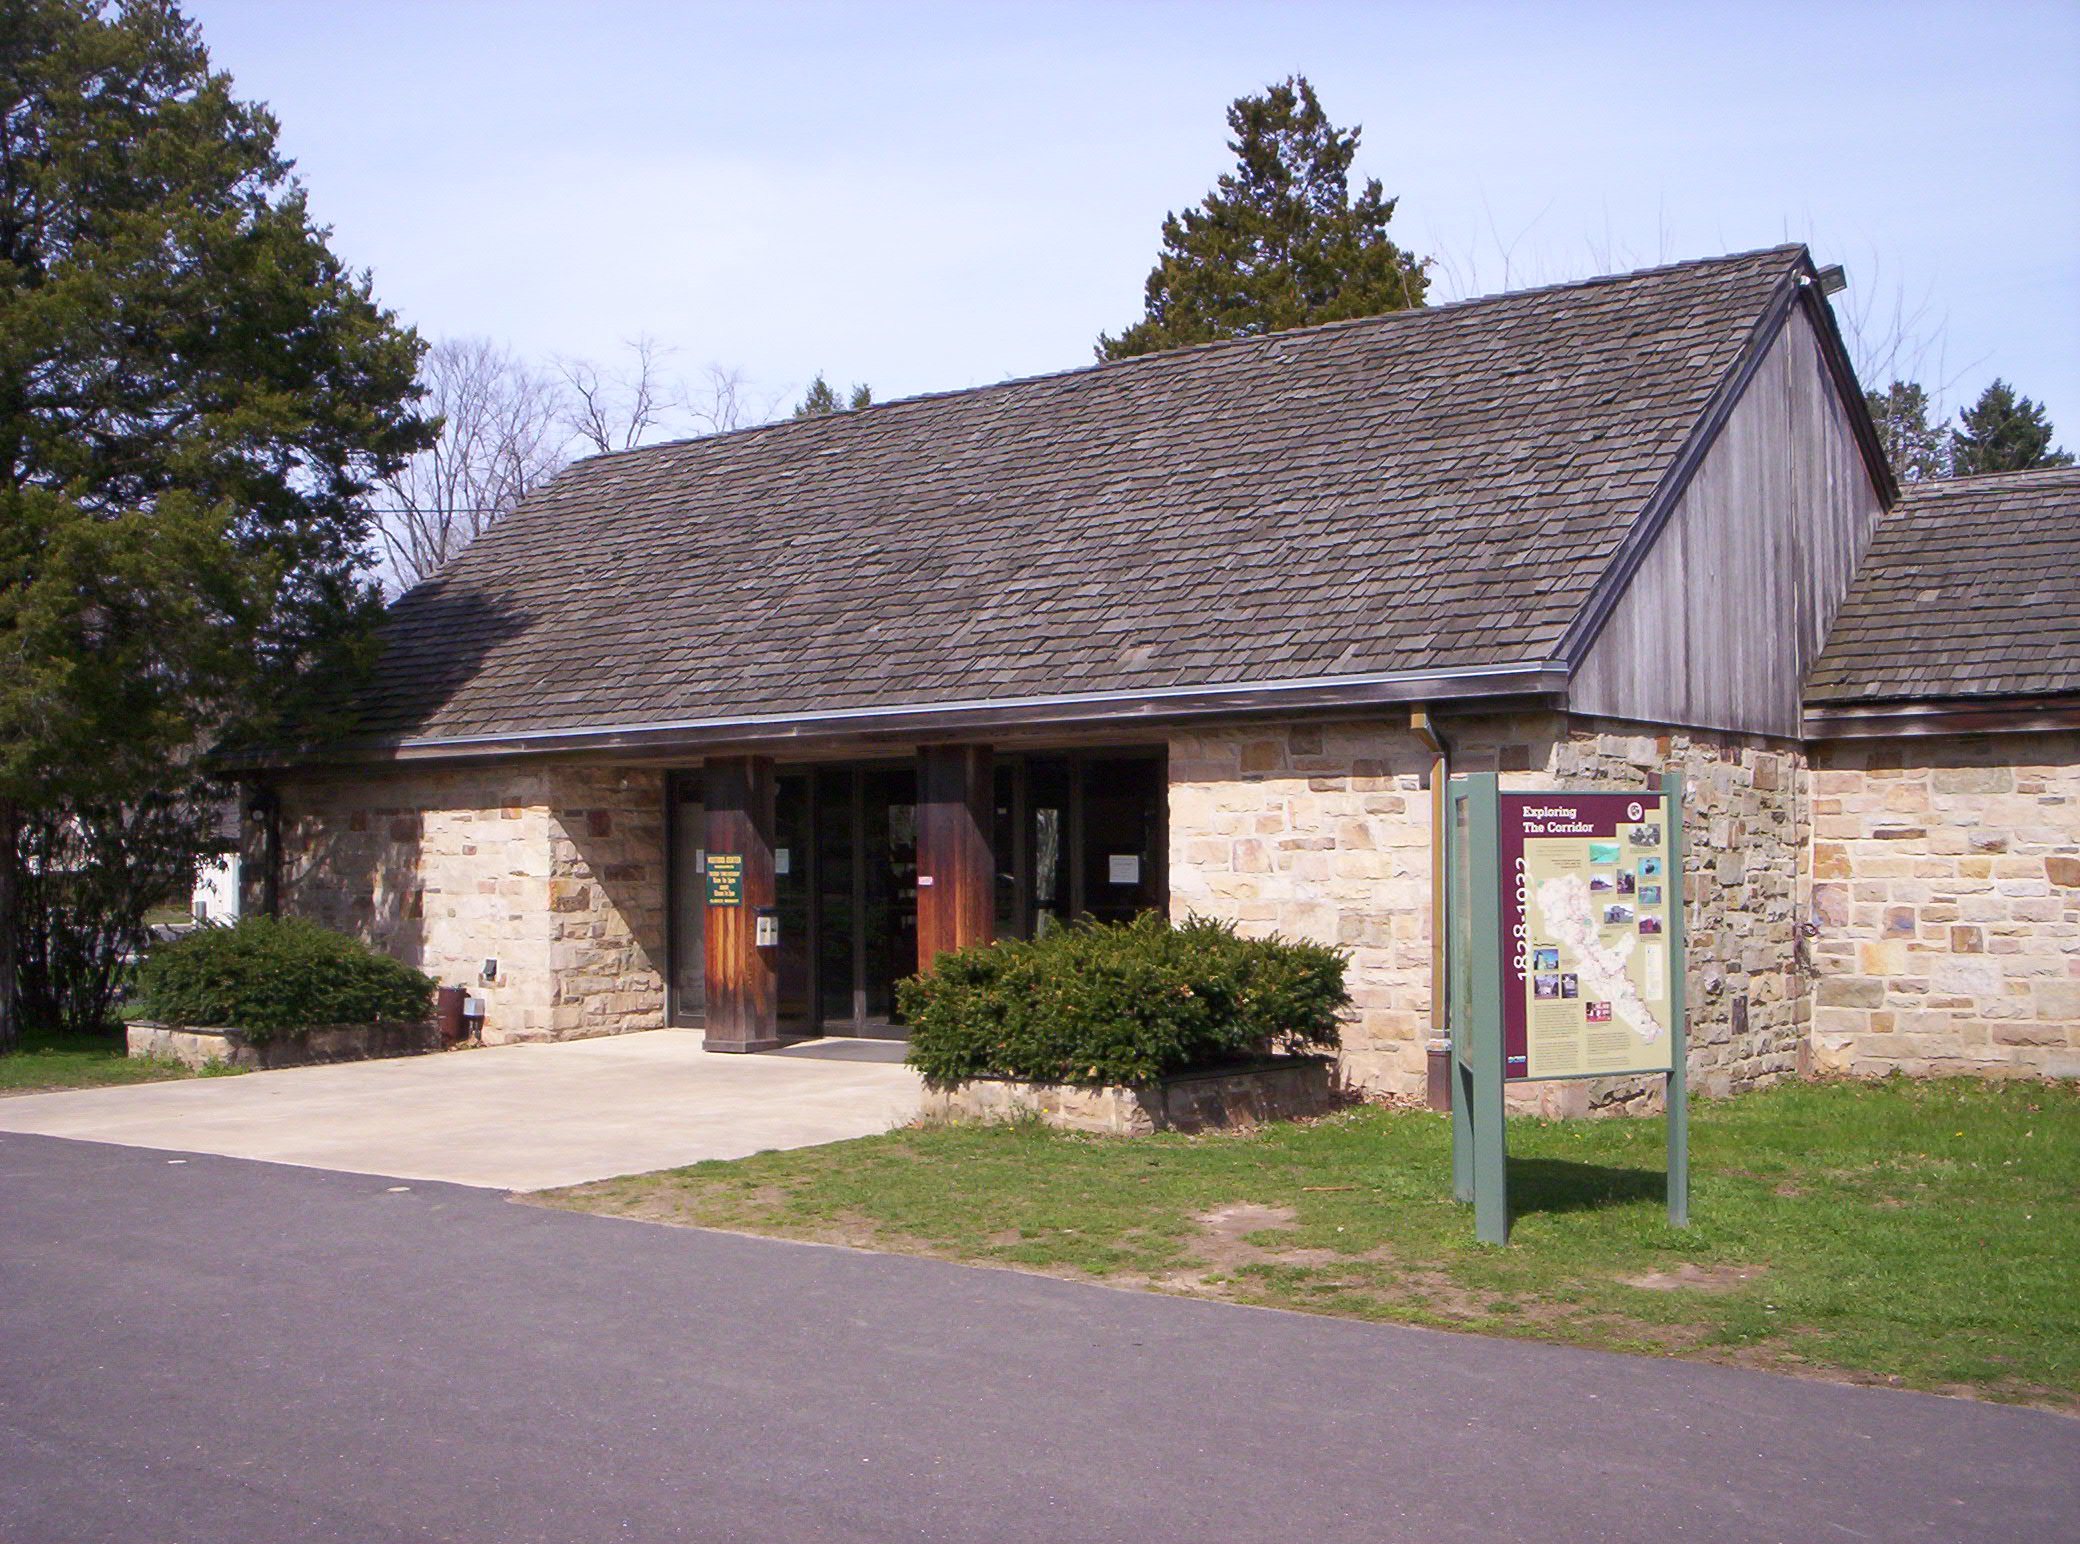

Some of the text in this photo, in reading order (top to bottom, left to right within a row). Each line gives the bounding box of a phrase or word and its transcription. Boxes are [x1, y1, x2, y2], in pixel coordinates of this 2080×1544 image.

[1522, 806, 1577, 819] Exploring
[1522, 821, 1594, 833] The Corridor
[1513, 857, 1534, 981] 1828-1932
